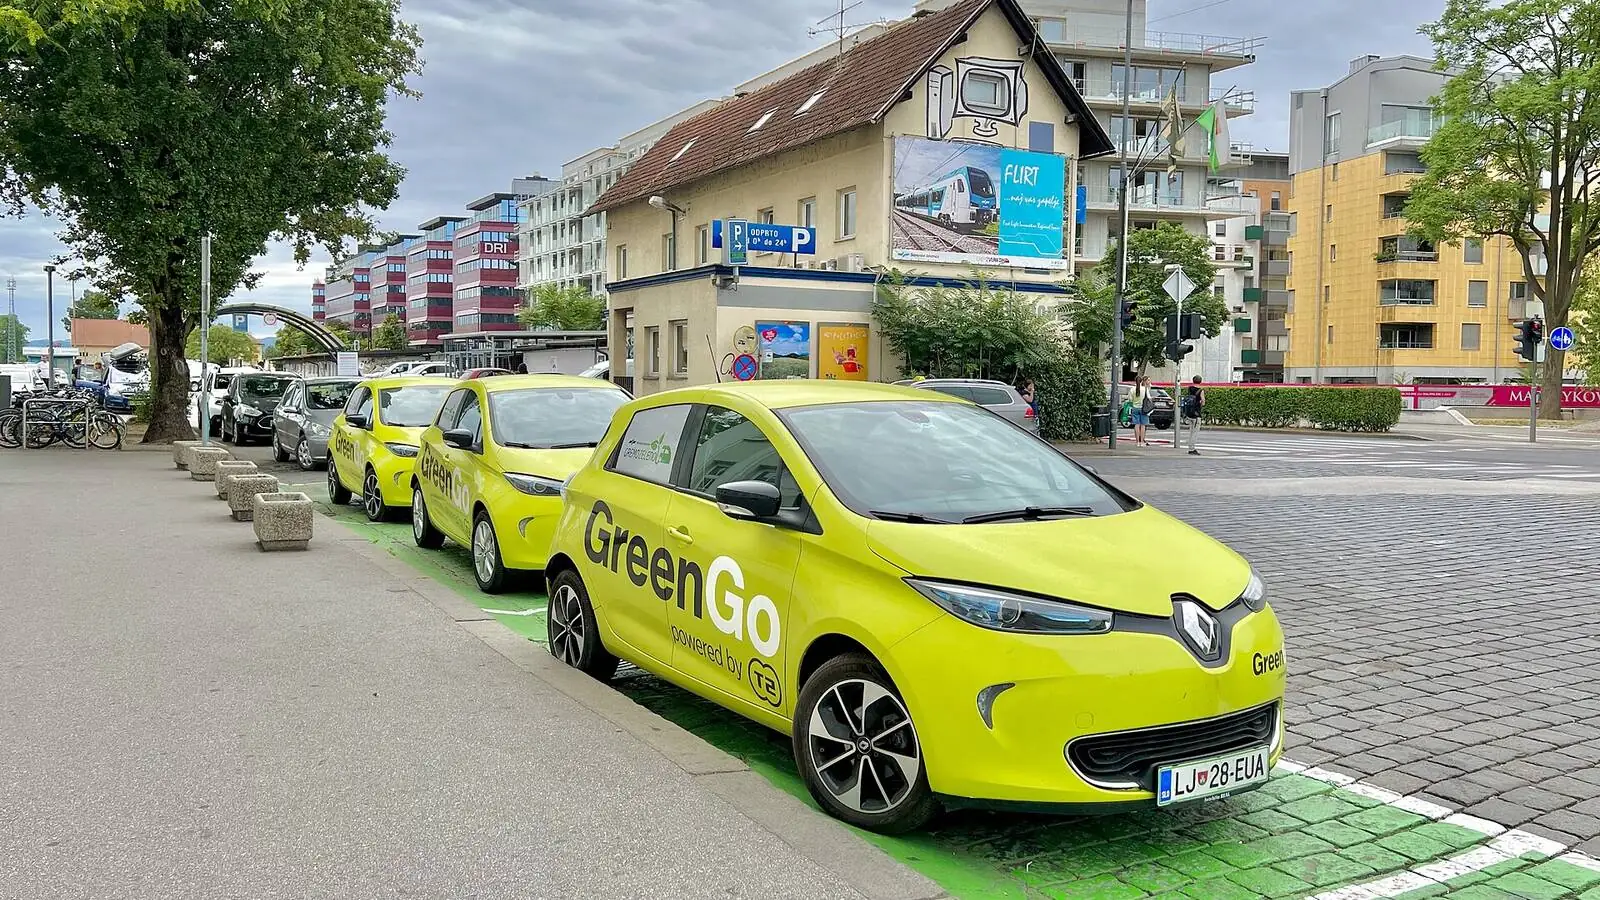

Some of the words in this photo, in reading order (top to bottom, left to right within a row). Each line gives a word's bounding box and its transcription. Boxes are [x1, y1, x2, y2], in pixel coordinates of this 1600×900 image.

[1004, 164, 1040, 187] FLIRT
[734, 224, 742, 241] P
[750, 228, 779, 238] ODPRTO
[791, 227, 811, 252] P
[484, 242, 508, 254] DRI
[235, 315, 246, 327] P
[421, 441, 470, 517] GreenGo
[584, 500, 781, 657] GreenGo
[671, 625, 724, 668] powered
[726, 648, 743, 681] by
[1175, 768, 1197, 796] LJ
[1209, 753, 1265, 788] 28-EUA
